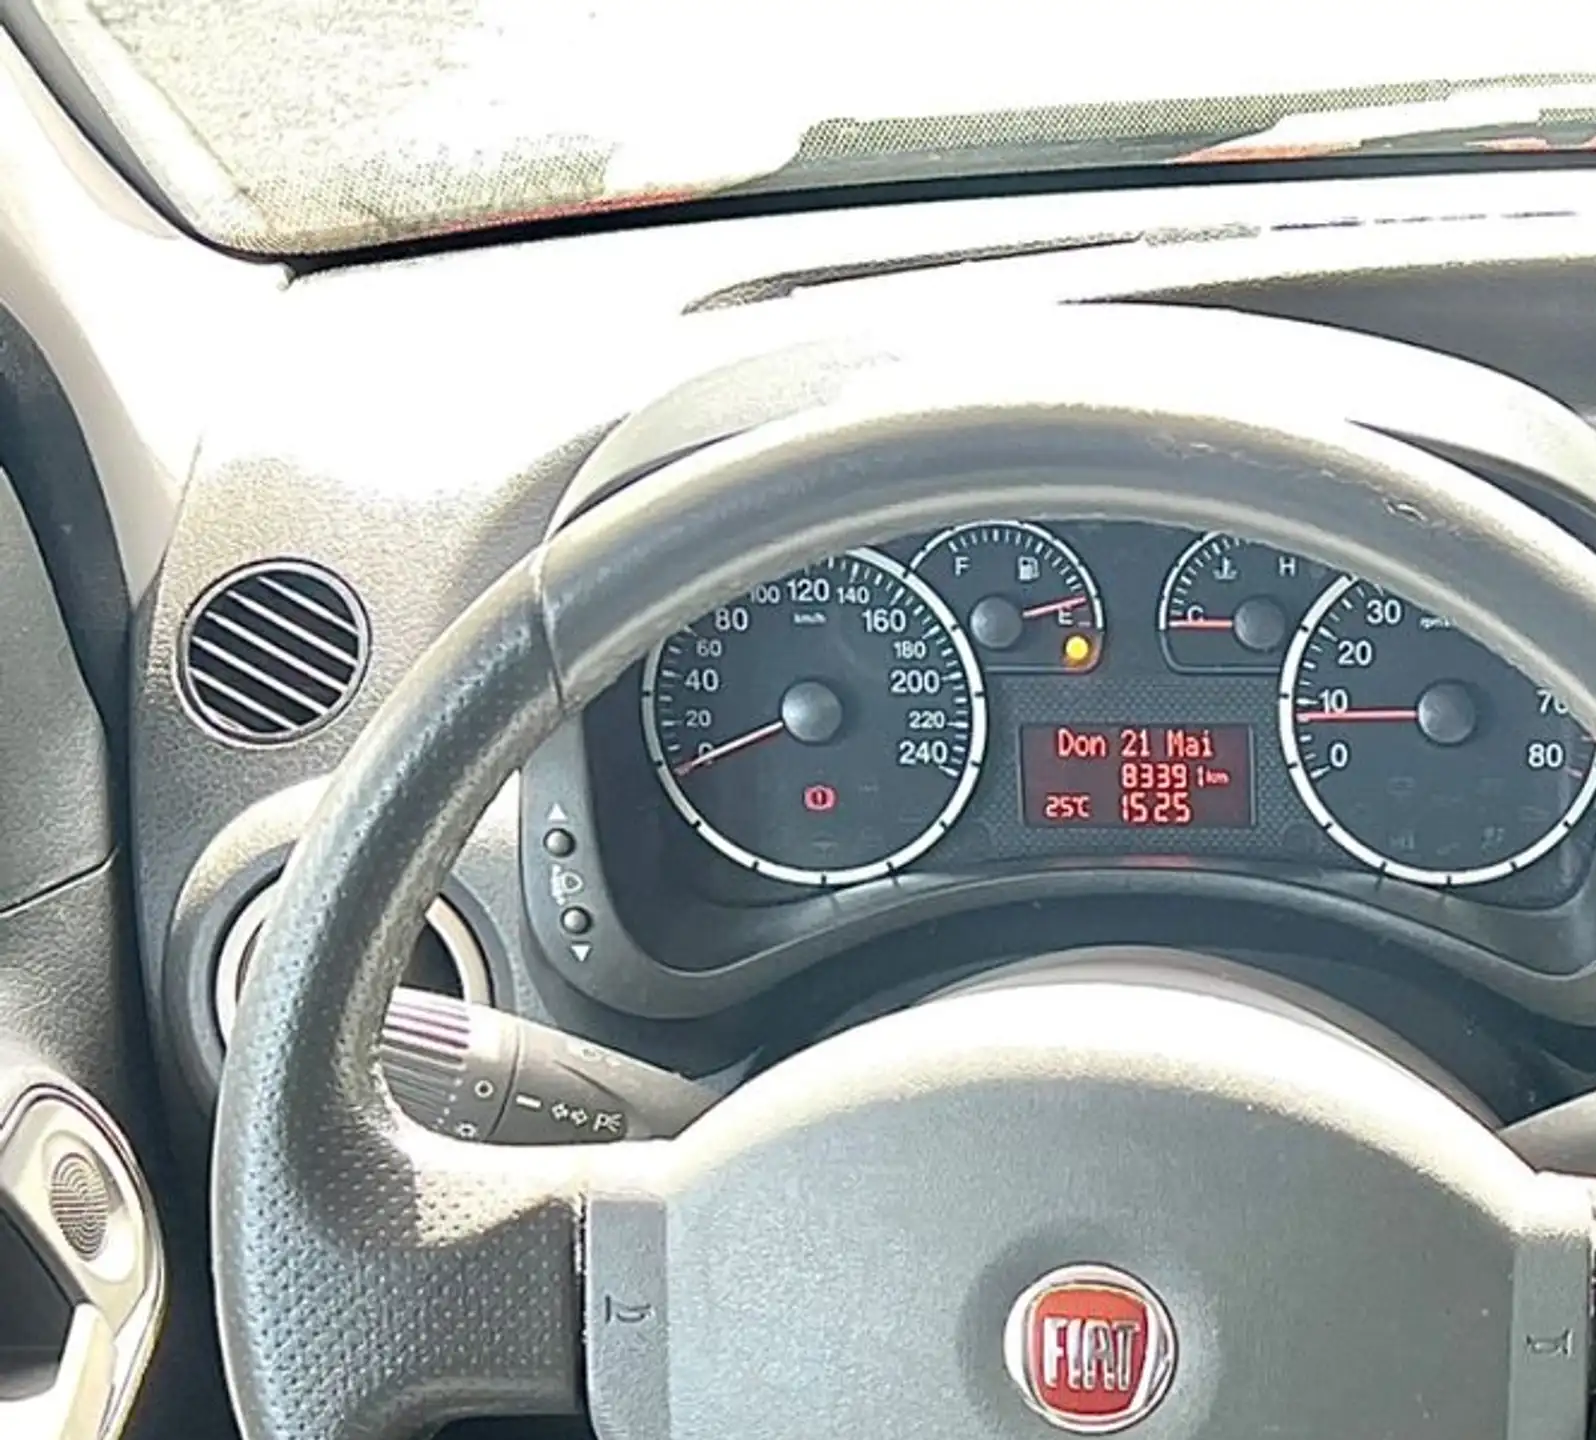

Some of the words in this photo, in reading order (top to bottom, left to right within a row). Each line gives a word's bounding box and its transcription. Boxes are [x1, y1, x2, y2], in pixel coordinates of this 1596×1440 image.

[954, 556, 970, 577] F
[1278, 555, 1296, 578] H
[787, 577, 831, 602] 120
[836, 586, 870, 604] 140
[715, 607, 749, 631] 80
[862, 608, 908, 633] 160
[1366, 599, 1402, 625] 30
[696, 639, 723, 657] 60
[893, 639, 927, 660] 180
[1337, 640, 1373, 667] 20
[684, 668, 720, 692] 40
[889, 668, 941, 694] 200
[1318, 688, 1349, 715] 10
[685, 709, 712, 728] 20
[908, 710, 946, 729] 220
[898, 739, 949, 766] 240
[1057, 728, 1106, 757] Don
[1120, 729, 1150, 757] 21
[1166, 729, 1213, 757] Mai
[1329, 742, 1349, 768] 0
[1528, 743, 1564, 769] 80
[1043, 1317, 1141, 1392] FIAT
